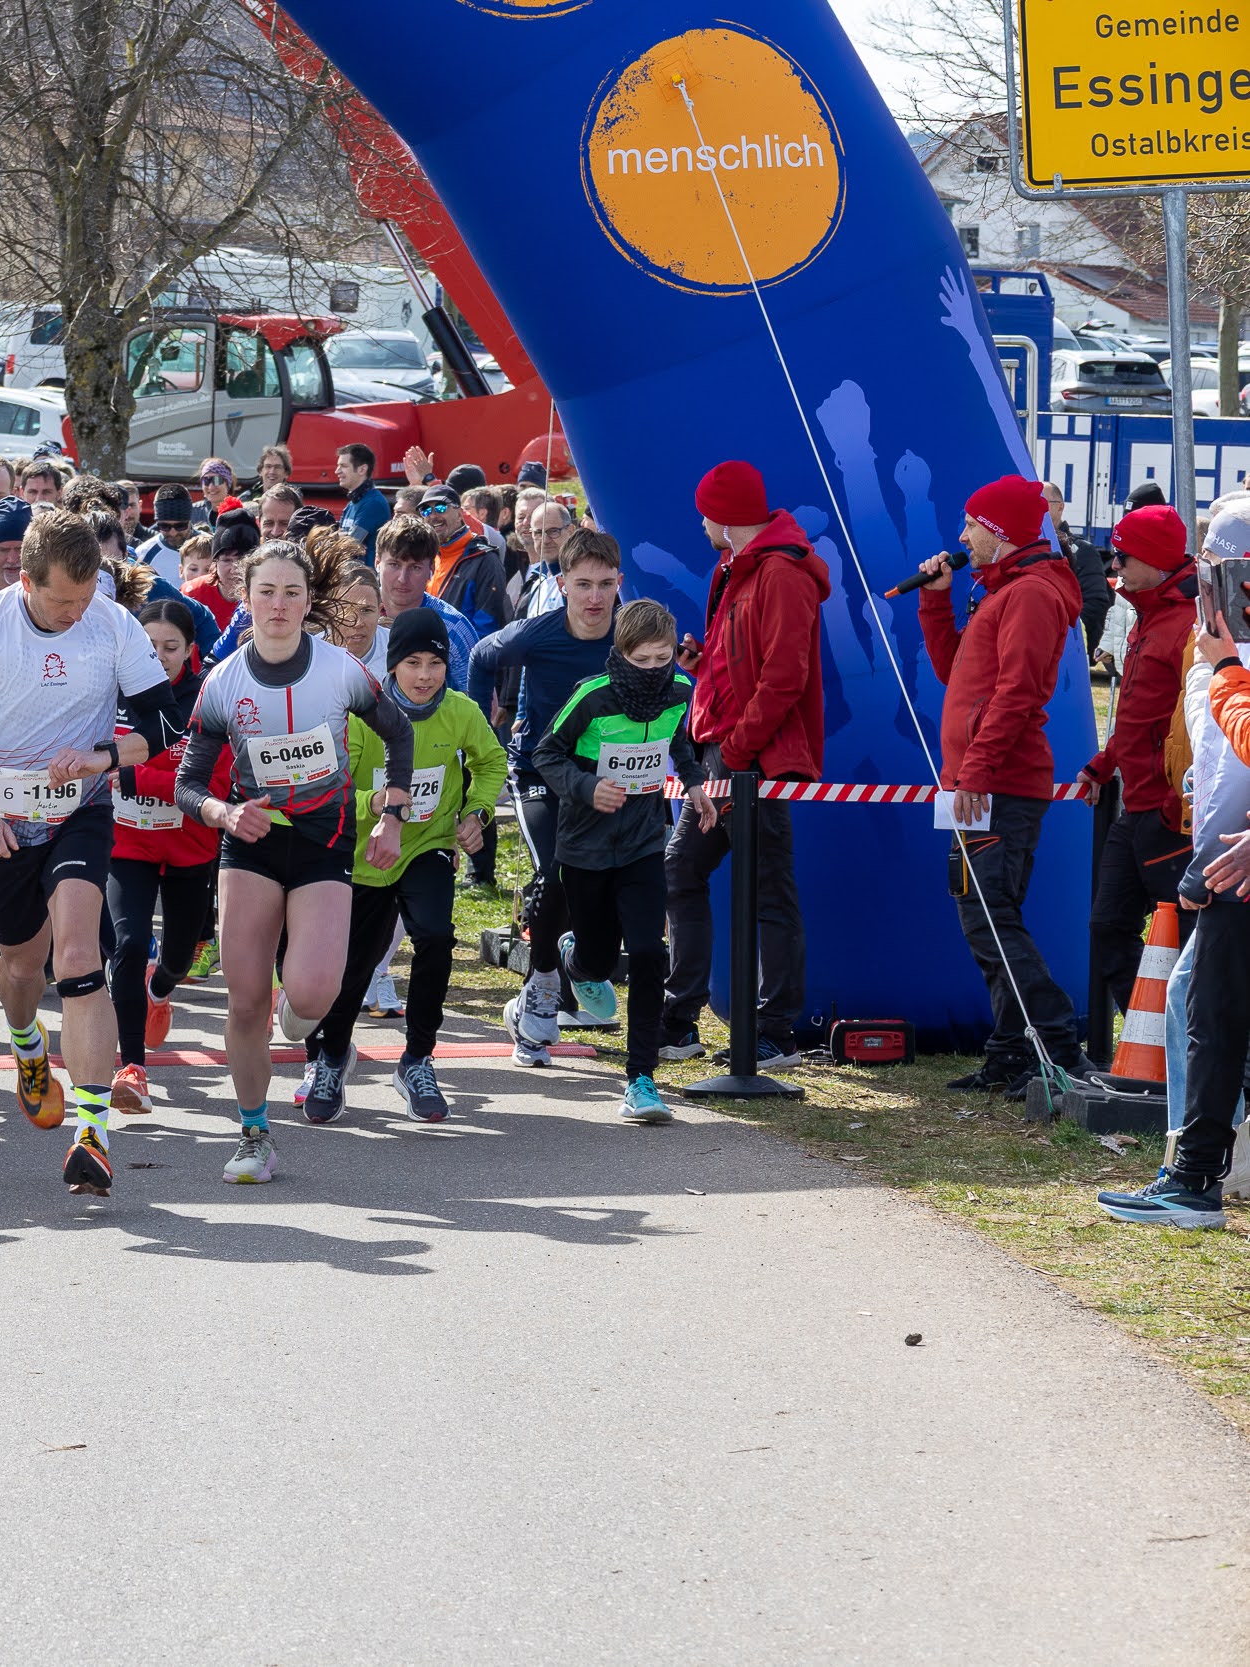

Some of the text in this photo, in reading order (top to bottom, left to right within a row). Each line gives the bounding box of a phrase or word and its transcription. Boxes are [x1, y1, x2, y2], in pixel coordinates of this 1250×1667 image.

[1095, 8, 1240, 39] Gemeinde
[1053, 61, 1250, 115] Essinge
[607, 134, 825, 175] menschlich
[1090, 126, 1250, 158] Ostalbkreis
[260, 740, 325, 765] 6-0466
[608, 753, 662, 770] 6-0723
[285, 763, 306, 771] Saskia
[528, 785, 547, 797] 28
